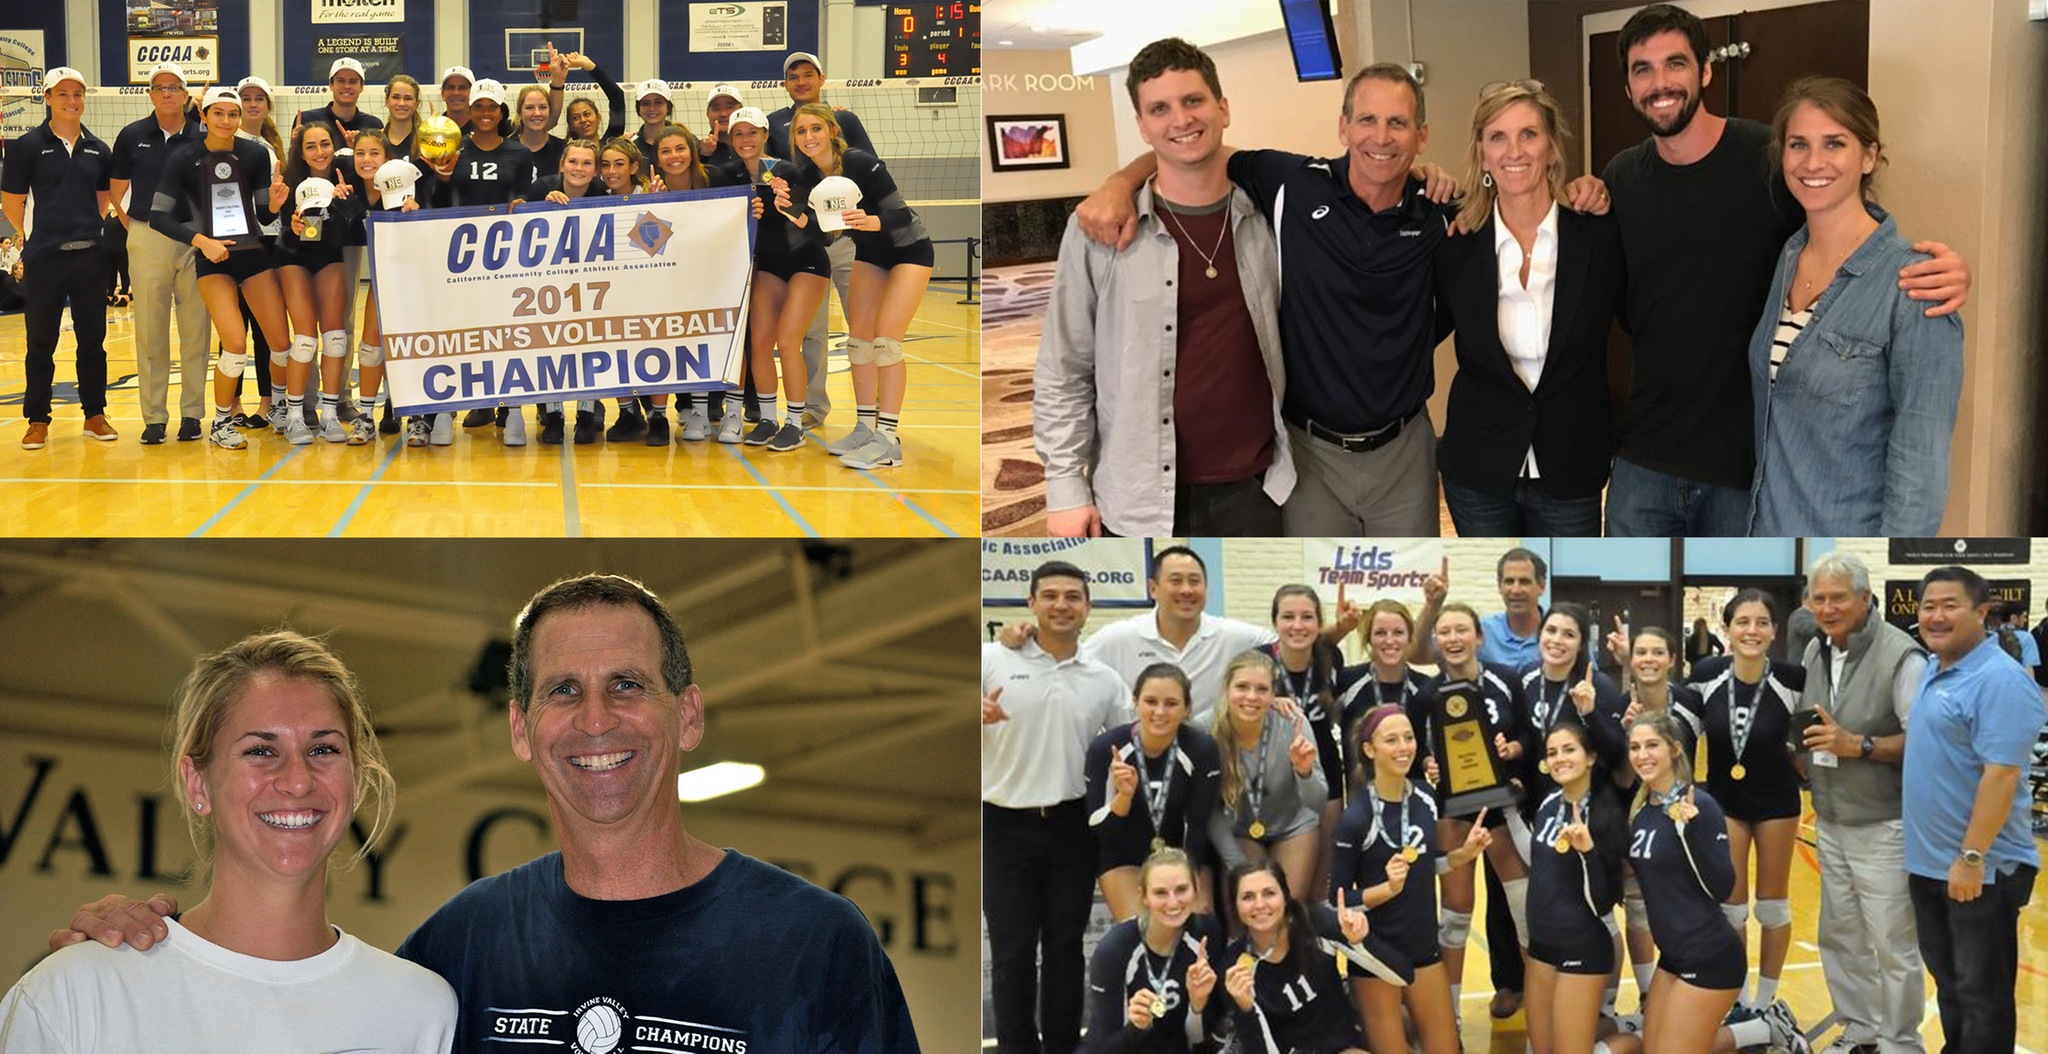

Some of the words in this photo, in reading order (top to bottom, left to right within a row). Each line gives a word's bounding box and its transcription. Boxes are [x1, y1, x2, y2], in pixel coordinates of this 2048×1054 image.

[350, 9, 370, 17] real
[370, 11, 395, 20] game
[894, 7, 912, 15] Home
[903, 16, 914, 32] 0
[930, 29, 951, 37] period
[12, 39, 35, 56] College
[318, 39, 325, 47] A
[327, 38, 362, 46] LEGEND
[363, 38, 372, 46] IS
[374, 37, 399, 46] BUILT
[335, 46, 359, 54] STORY
[137, 45, 192, 63] CCCAA
[900, 53, 907, 66] 3
[937, 53, 946, 64] 4
[931, 68, 948, 76] game
[565, 83, 592, 91] CCCAA
[751, 81, 778, 89] CCCAA
[845, 79, 874, 88] CCCAA
[944, 77, 973, 85] CCCAA
[1024, 73, 1095, 92] ROOM
[119, 86, 144, 95] CCCAA
[294, 86, 320, 94] CCCAA
[421, 138, 447, 148] molten
[470, 161, 498, 181] 12
[447, 213, 615, 274] CCCAA
[446, 274, 491, 284] California
[494, 270, 543, 280] Community
[546, 267, 579, 276] College
[583, 264, 619, 273] Athletic
[623, 260, 677, 270] Association
[512, 281, 611, 317] 2017
[388, 326, 532, 358] WOMEN'S
[541, 310, 736, 346] VOLLEYBALL
[423, 343, 711, 401] CHAMPION
[1334, 545, 1394, 571] Lids
[1319, 567, 1365, 584] Team
[1531, 701, 1550, 728] 9
[1150, 781, 1163, 809] 7
[1629, 829, 1657, 858] 21
[1282, 974, 1318, 1012] 11
[573, 996, 600, 1017] IRVINE
[602, 996, 630, 1019] VALLEY
[494, 1017, 553, 1035] STATE
[635, 1026, 747, 1054] CHAMPIONS
